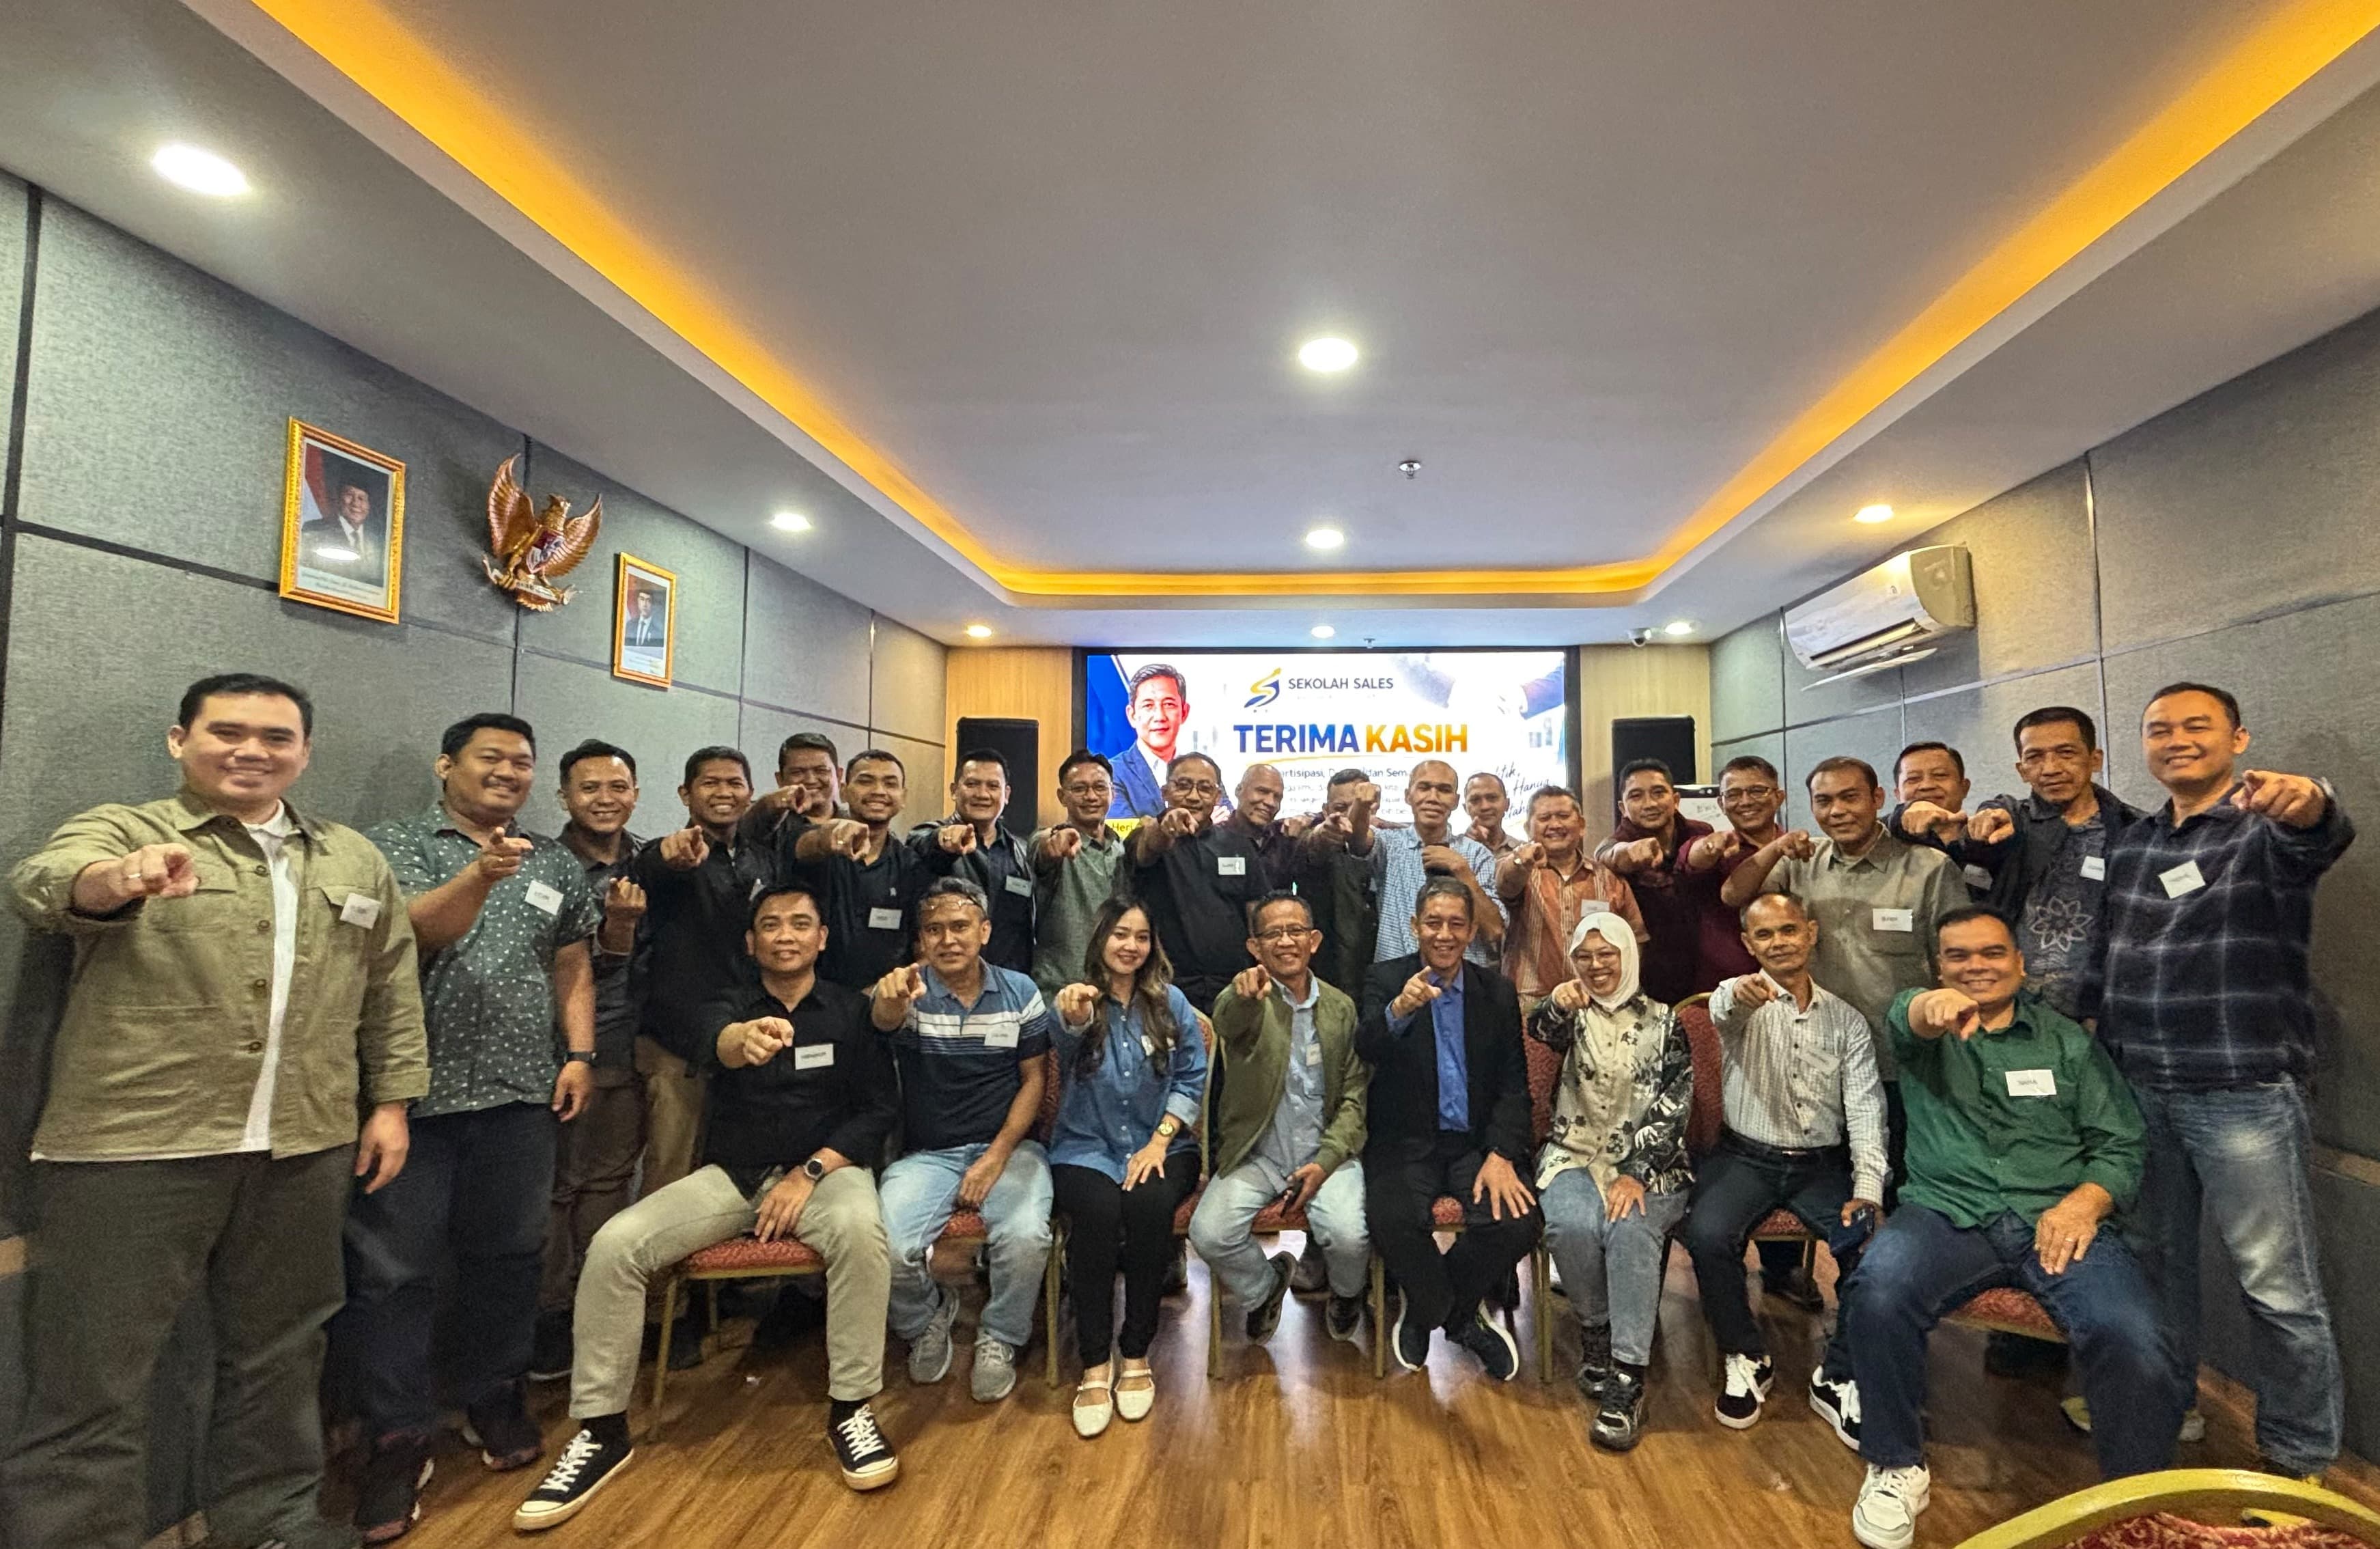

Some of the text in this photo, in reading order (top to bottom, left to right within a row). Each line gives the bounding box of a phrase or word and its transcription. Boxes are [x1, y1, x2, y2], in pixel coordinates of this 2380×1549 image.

[1288, 678, 1394, 690] SEKOLAH SALES
[1233, 724, 1468, 753] TERIMA KASIH
[1386, 768, 1409, 777] Sem
[1112, 822, 1132, 832] Heri
